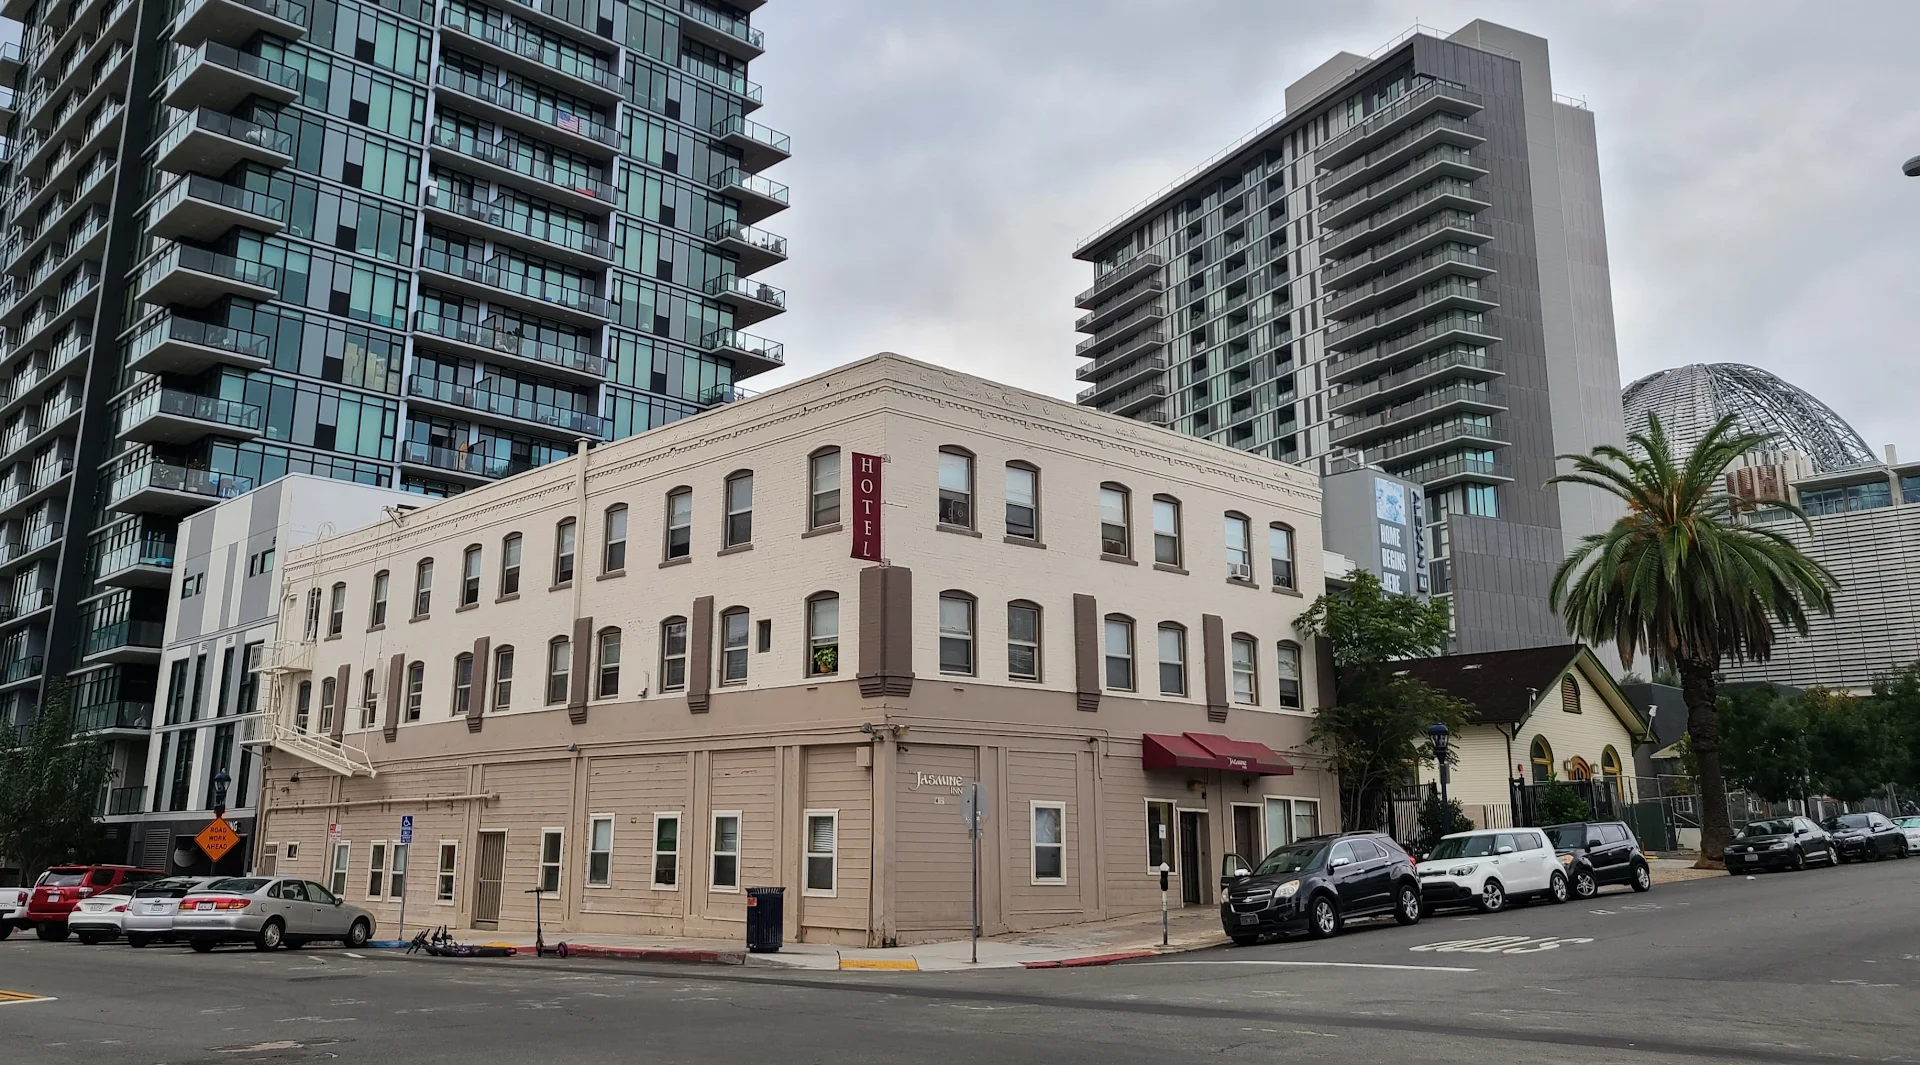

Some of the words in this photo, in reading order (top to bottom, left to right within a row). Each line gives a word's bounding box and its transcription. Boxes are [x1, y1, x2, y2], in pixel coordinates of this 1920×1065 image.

[861, 456, 874, 557] HOTEL
[1380, 523, 1402, 547] HOME
[1412, 491, 1425, 569] ALEXAN
[1382, 548, 1407, 572] BEGINS
[950, 786, 963, 795] INN
